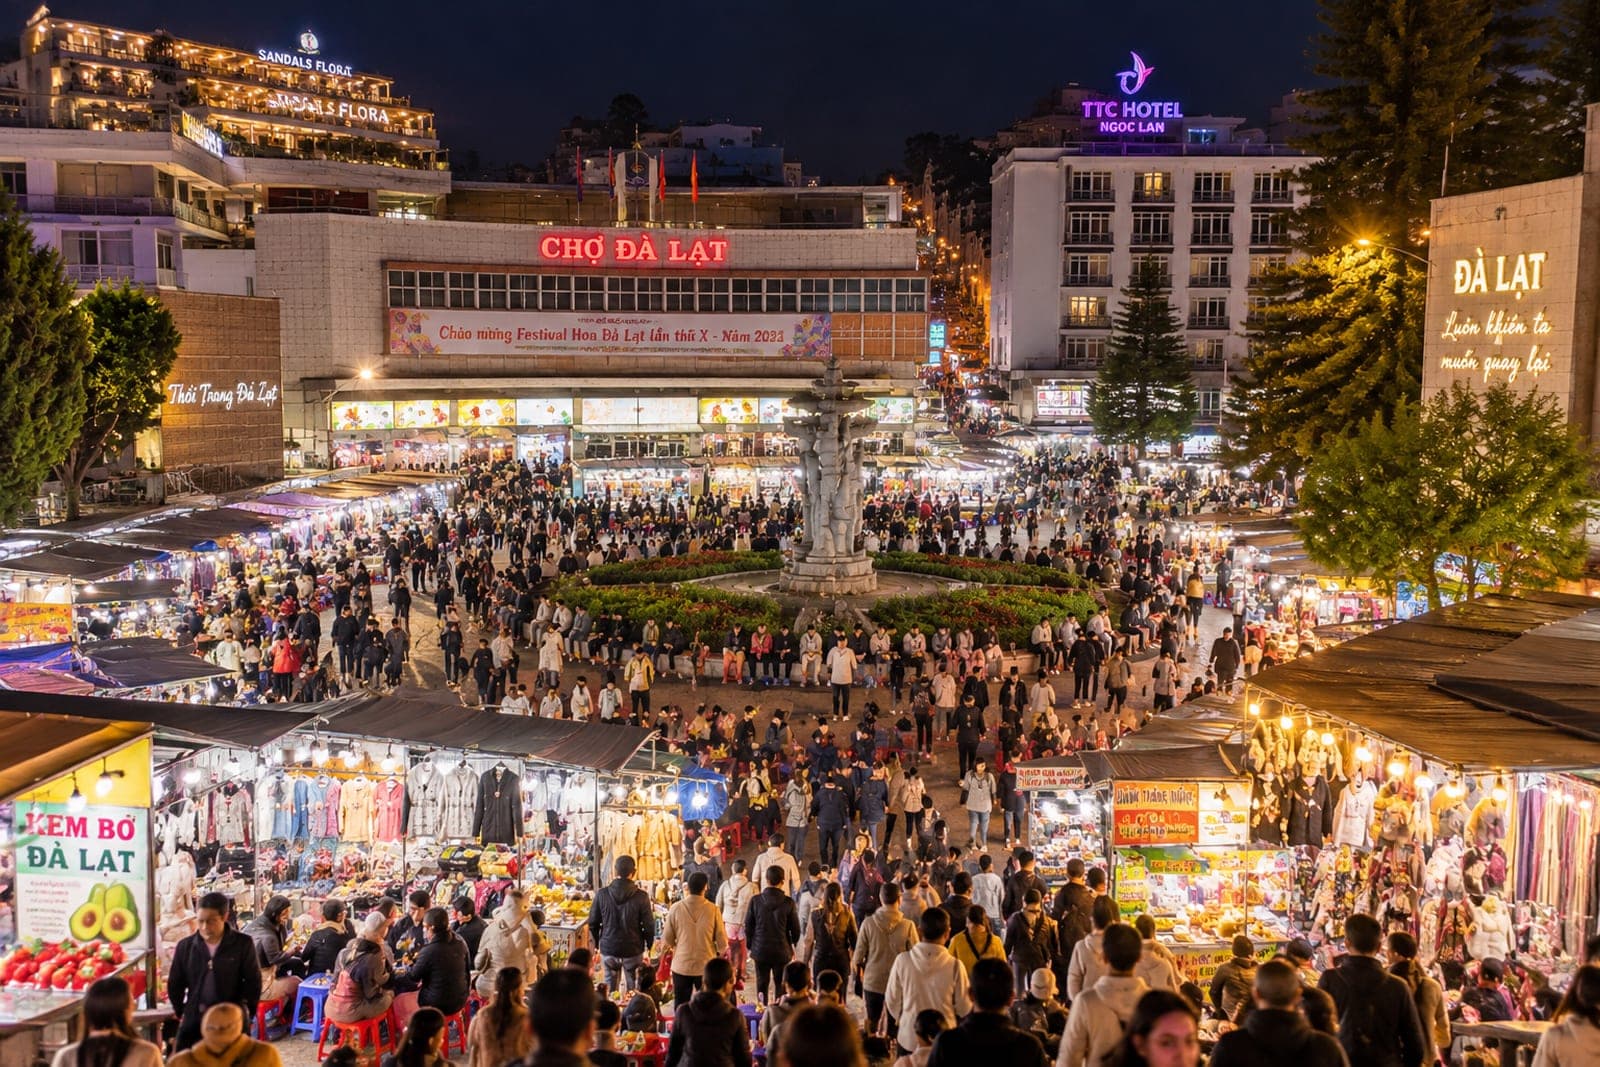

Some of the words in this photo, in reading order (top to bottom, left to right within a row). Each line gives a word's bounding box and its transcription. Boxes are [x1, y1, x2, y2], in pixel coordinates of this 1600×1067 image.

[258, 49, 312, 70] SANDALS
[339, 102, 389, 124] FLORA
[1082, 101, 1118, 118] TTC
[1122, 101, 1183, 118] HOTEL
[1138, 122, 1165, 133] LAN
[541, 236, 604, 264] CHỢ
[615, 235, 657, 261] ĐÀ
[668, 241, 727, 266] LẠT
[1454, 247, 1488, 294] ĐÀ
[1496, 252, 1546, 299] LẠT
[1533, 311, 1552, 334] ta
[517, 328, 567, 340] Festival
[624, 329, 645, 344] Lạt
[699, 329, 708, 342] X
[1483, 357, 1521, 383] quay
[1526, 345, 1551, 376] lại
[25, 812, 88, 838] KEM
[27, 841, 69, 870] ĐÀ
[79, 848, 135, 877] LẠT
